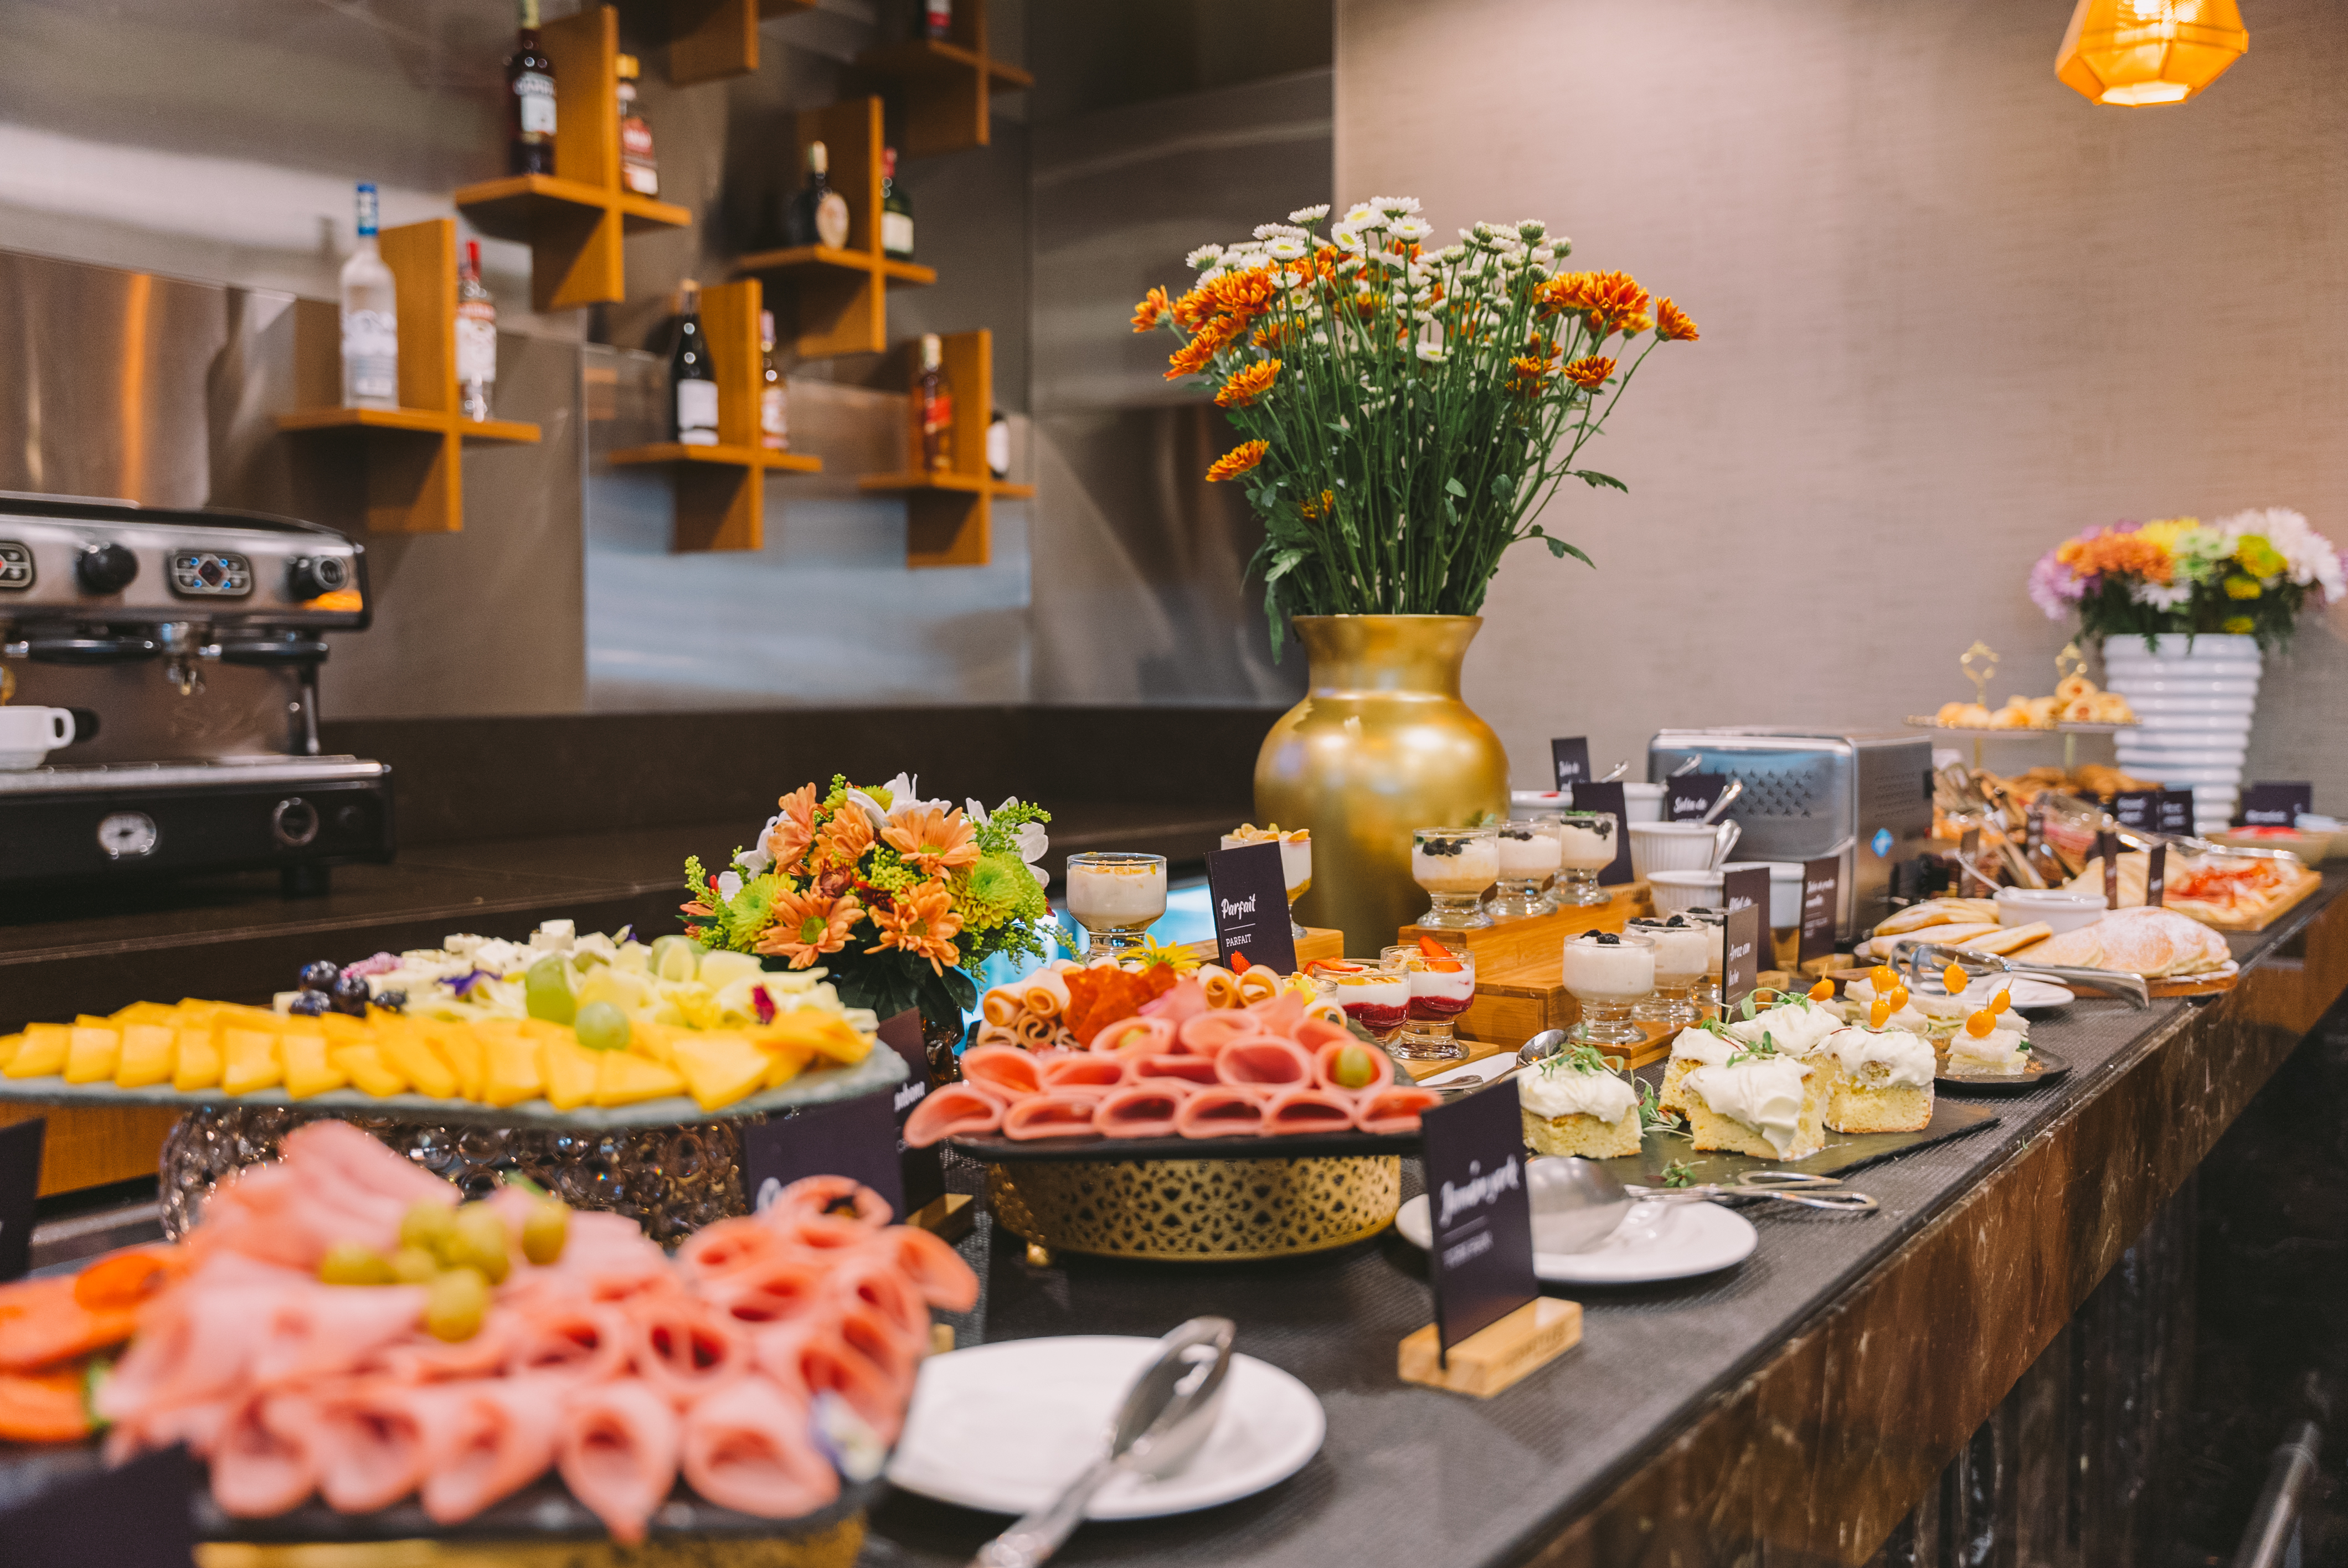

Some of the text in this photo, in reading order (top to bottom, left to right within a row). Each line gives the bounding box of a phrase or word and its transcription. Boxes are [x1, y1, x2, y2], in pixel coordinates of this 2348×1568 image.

[1221, 893, 1256, 920] Parfait
[1226, 934, 1252, 947] PARFAIT
[1729, 942, 1750, 962] Arroz con
[1728, 968, 1739, 987] leche
